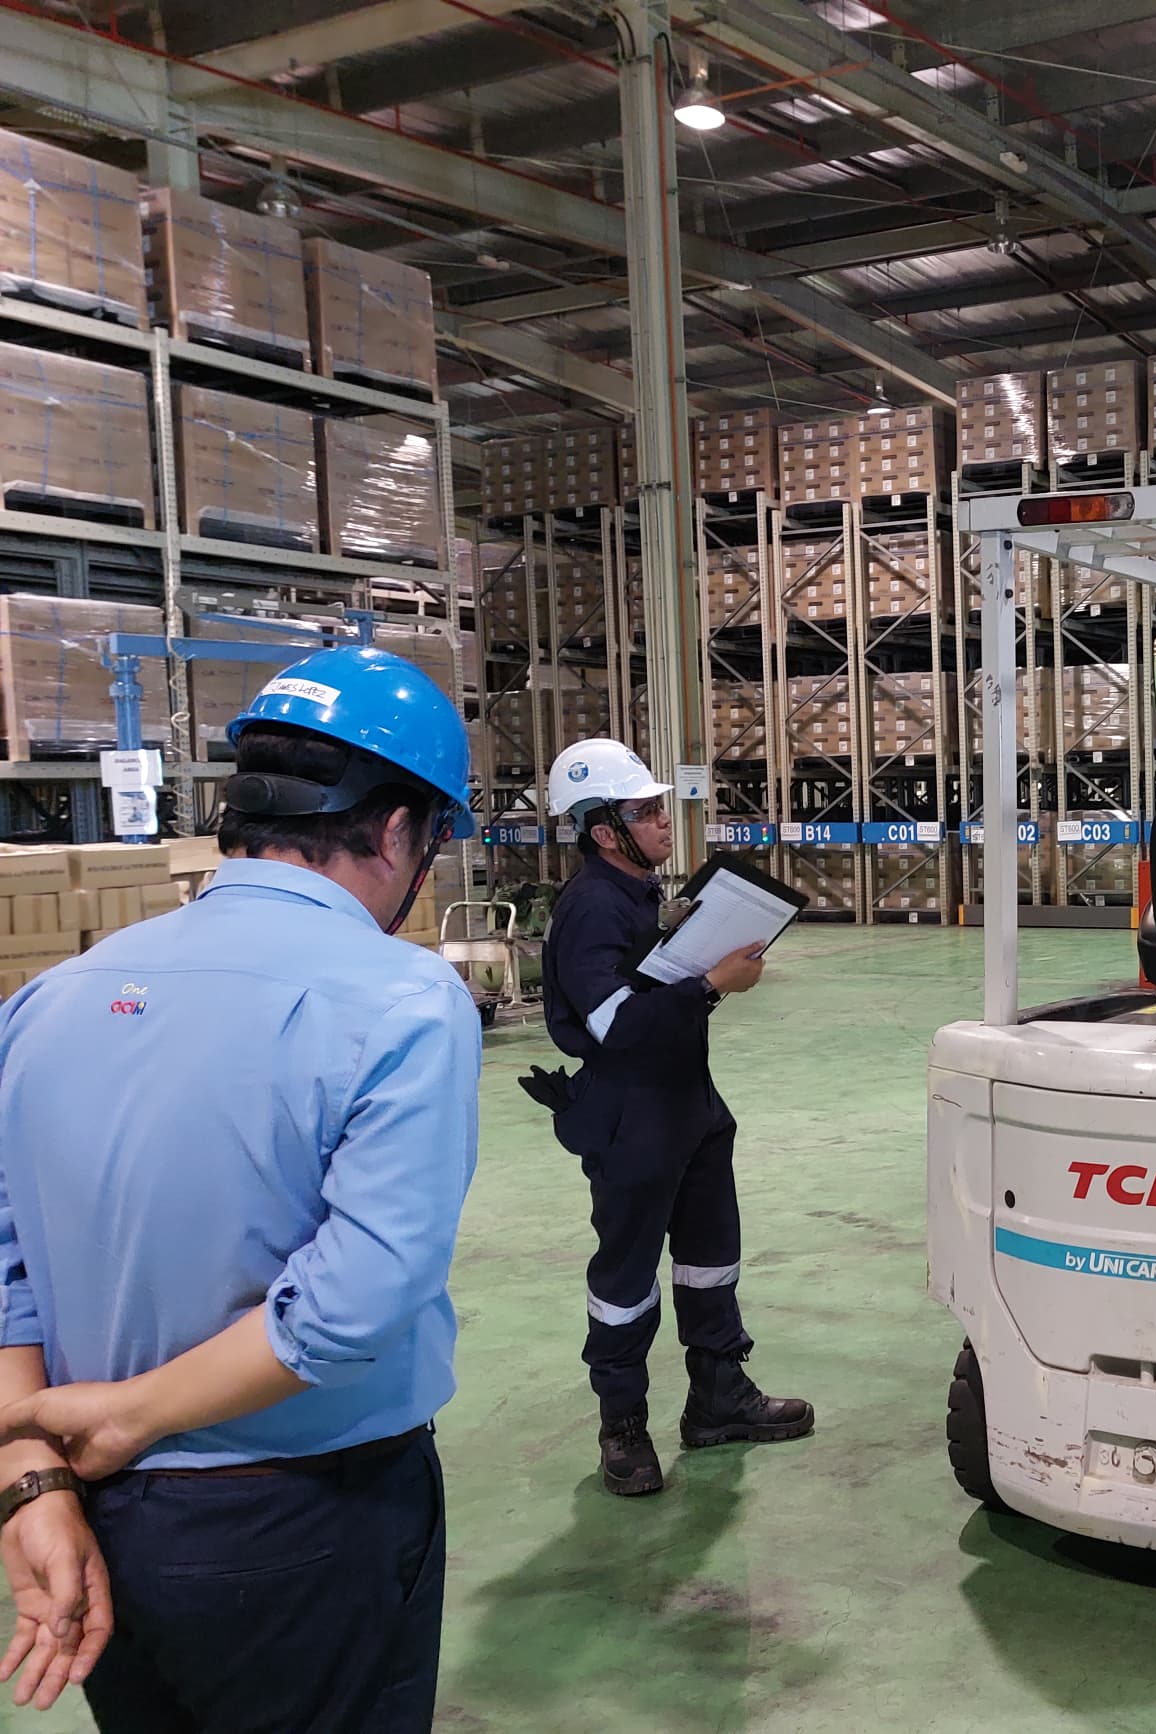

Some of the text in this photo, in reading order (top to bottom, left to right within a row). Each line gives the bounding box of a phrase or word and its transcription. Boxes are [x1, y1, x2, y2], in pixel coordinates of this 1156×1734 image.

[500, 828, 521, 843] B10
[726, 826, 751, 842] B13
[805, 824, 832, 841] B14
[888, 824, 915, 841] C01
[1017, 824, 1036, 841] 02
[1081, 823, 1111, 841] C03
[1065, 1251, 1086, 1271] by
